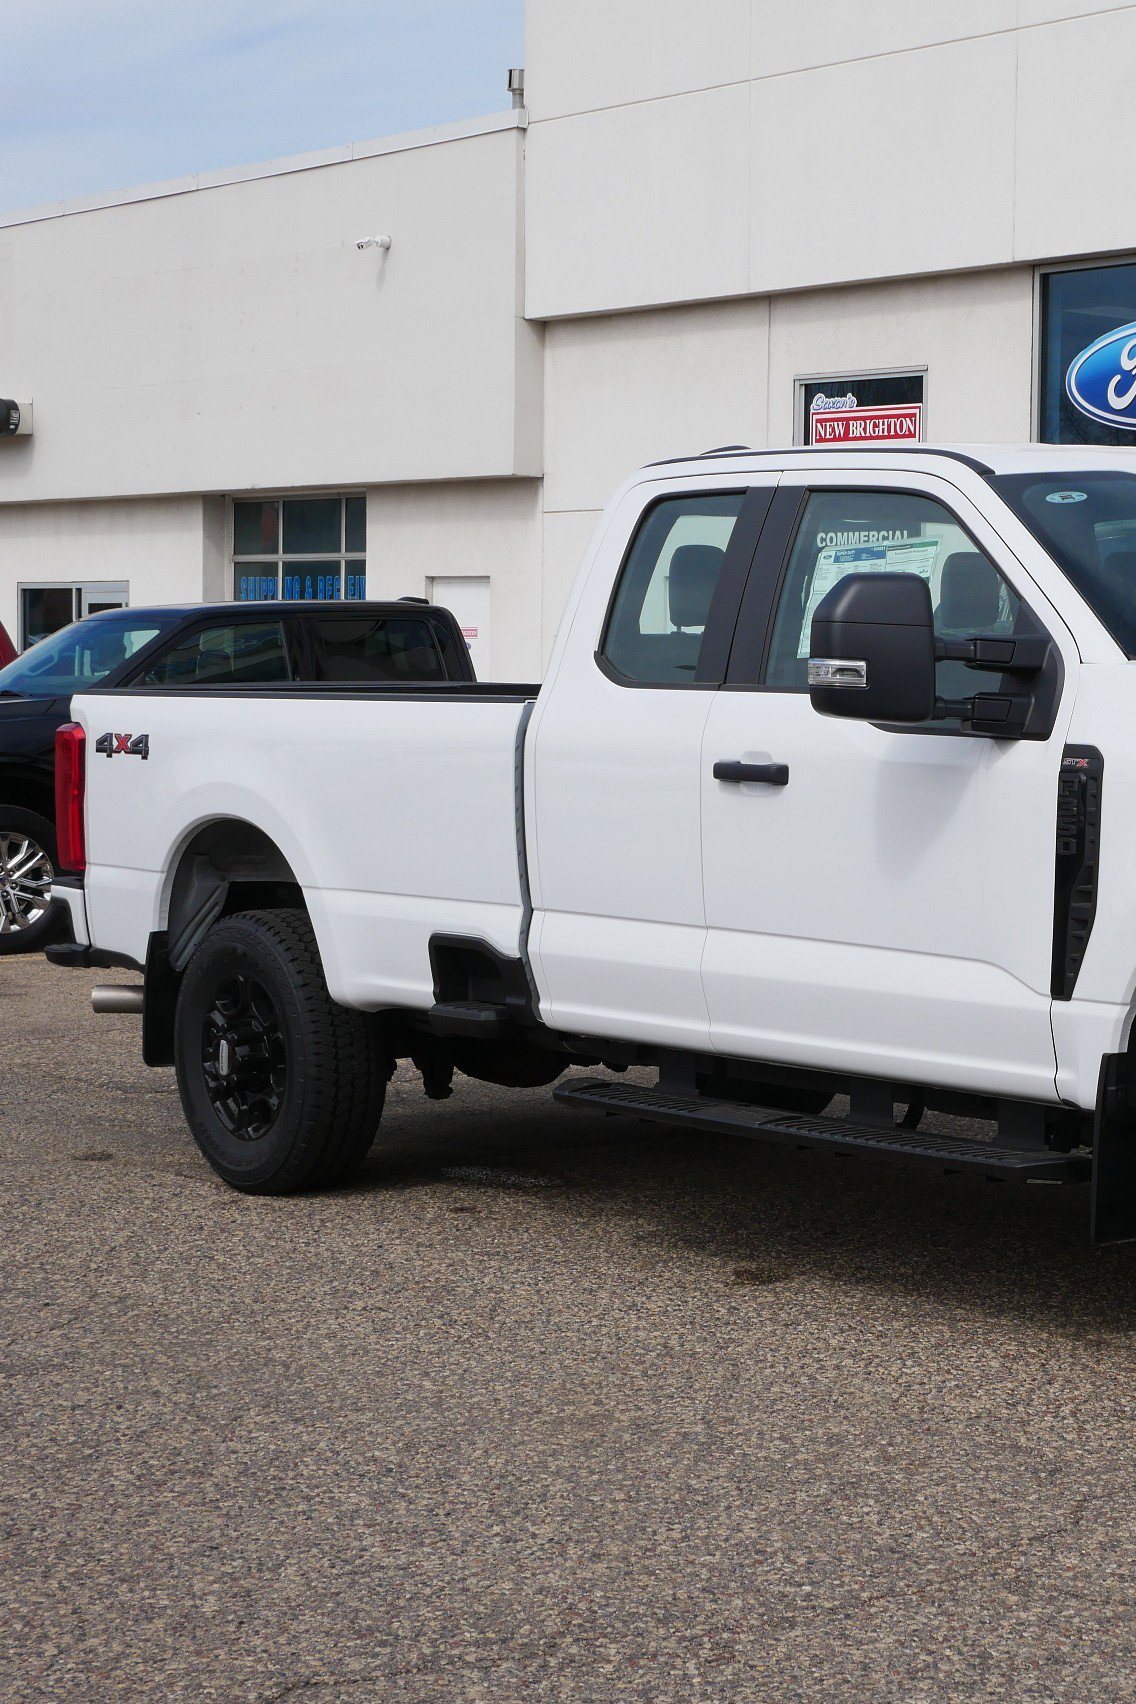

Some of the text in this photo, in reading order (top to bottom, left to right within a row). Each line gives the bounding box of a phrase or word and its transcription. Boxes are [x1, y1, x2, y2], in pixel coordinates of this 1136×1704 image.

[811, 393, 857, 411] Saxon's
[816, 417, 916, 439] NEW BRIGHTON
[305, 576, 313, 600] &
[1063, 757, 1089, 768] STX
